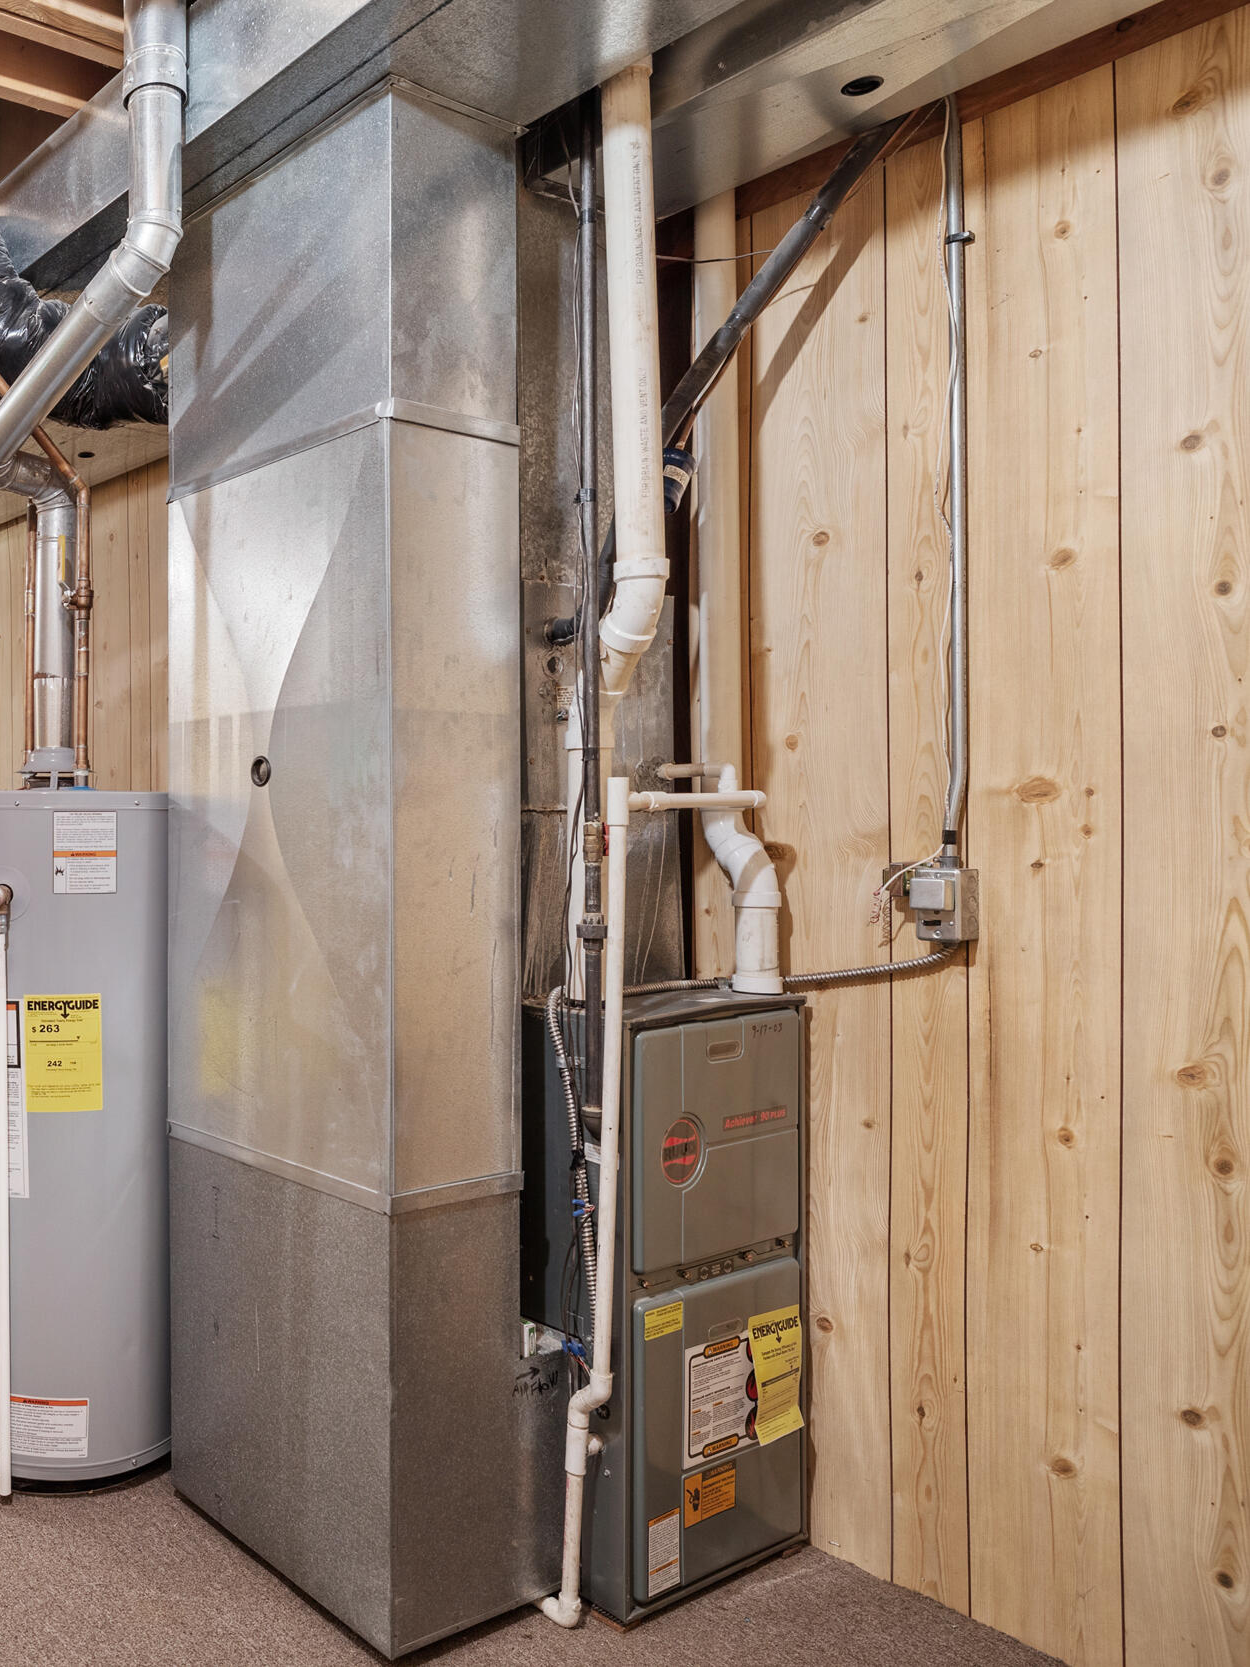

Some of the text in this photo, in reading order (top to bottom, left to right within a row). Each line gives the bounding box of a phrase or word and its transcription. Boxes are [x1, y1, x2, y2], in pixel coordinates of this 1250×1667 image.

[27, 999, 99, 1011] ENERGYGUIDE
[39, 1024, 60, 1033] 263
[752, 1316, 799, 1340] ENERGYGUIDE
